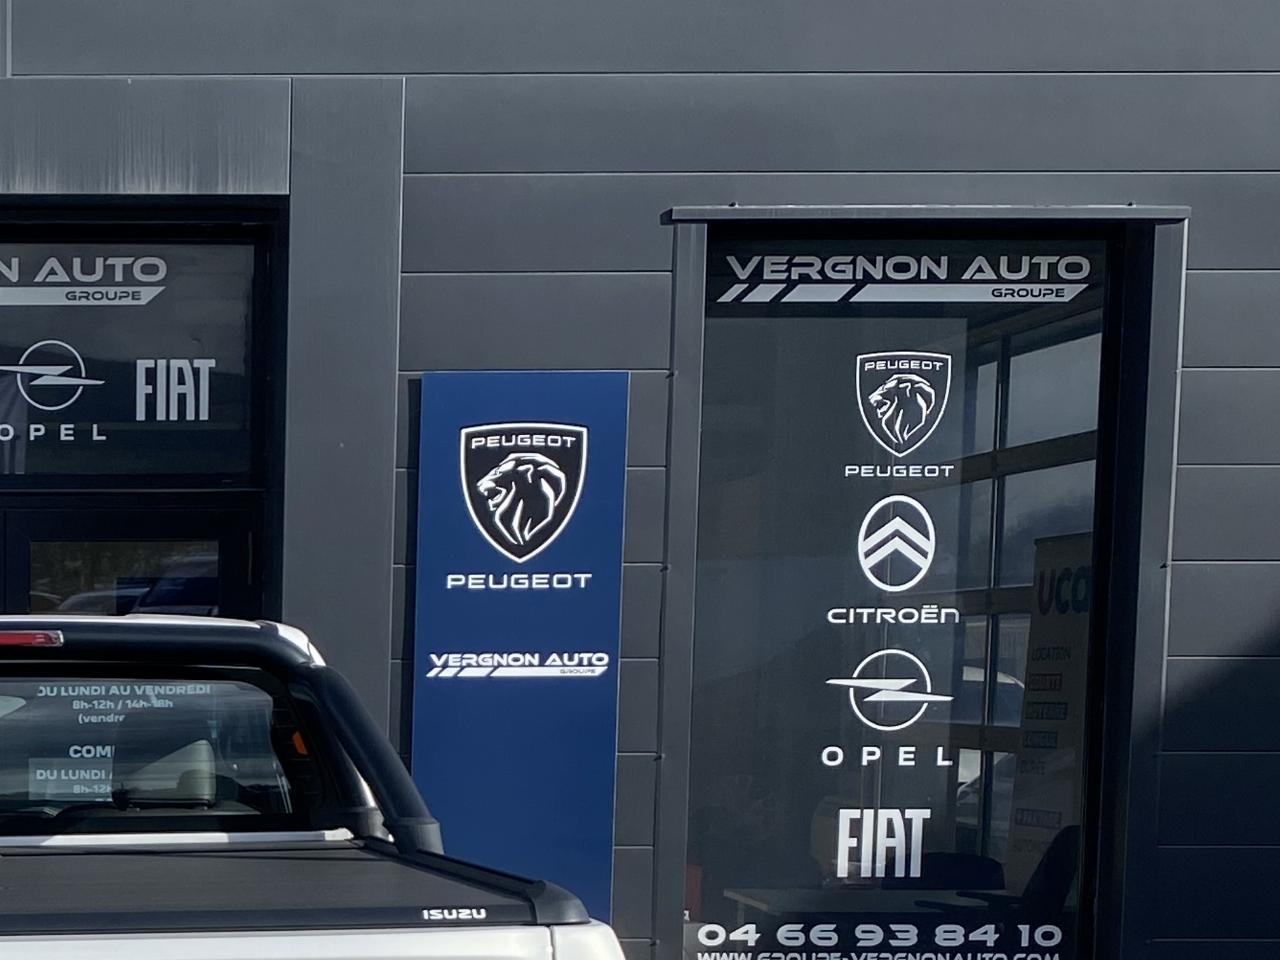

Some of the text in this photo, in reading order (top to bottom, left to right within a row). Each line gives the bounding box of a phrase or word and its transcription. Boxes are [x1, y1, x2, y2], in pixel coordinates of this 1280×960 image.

[34, 256, 167, 283] AUTO
[725, 255, 1091, 281] VERGNON AUTO
[65, 290, 143, 301] GROUPE
[991, 287, 1066, 298] GROUPE
[864, 359, 944, 371] PEUGEOT
[136, 359, 216, 420] FIAT
[471, 433, 577, 449] PEUGEOT
[845, 465, 955, 477] PEUGEOT
[446, 573, 593, 588] PEUGEOT
[827, 605, 960, 624] CITROËN
[429, 652, 609, 666] VERGNON AUTO
[60, 686, 106, 696] LUNDI
[108, 685, 131, 695] AU
[133, 684, 211, 695] VENDREDI
[72, 700, 114, 709] 8h-12h
[821, 746, 953, 766] OPEL
[36, 769, 58, 780] DU
[60, 769, 106, 780] LUNDI
[836, 808, 931, 877] FIAT
[422, 908, 487, 919] ISUZU
[697, 923, 1063, 947] 04 66 93 84 10
